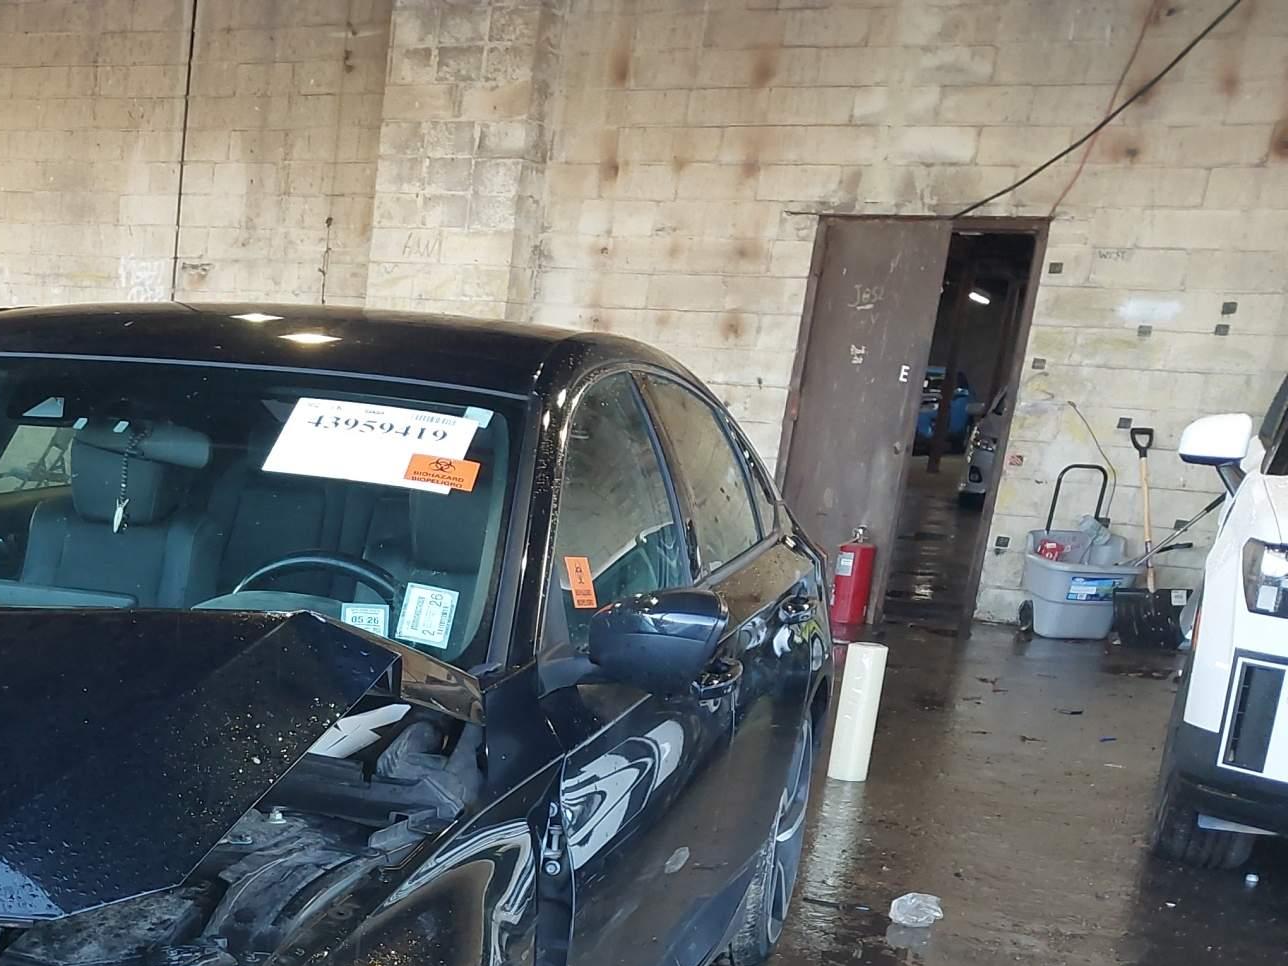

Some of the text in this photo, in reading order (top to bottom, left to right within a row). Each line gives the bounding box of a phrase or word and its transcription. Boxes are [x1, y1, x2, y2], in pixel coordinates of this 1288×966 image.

[898, 364, 910, 382] E
[307, 414, 448, 442] 43959419
[411, 475, 463, 489] BIOPELIGRO
[413, 470, 465, 483] BIOHAZARD
